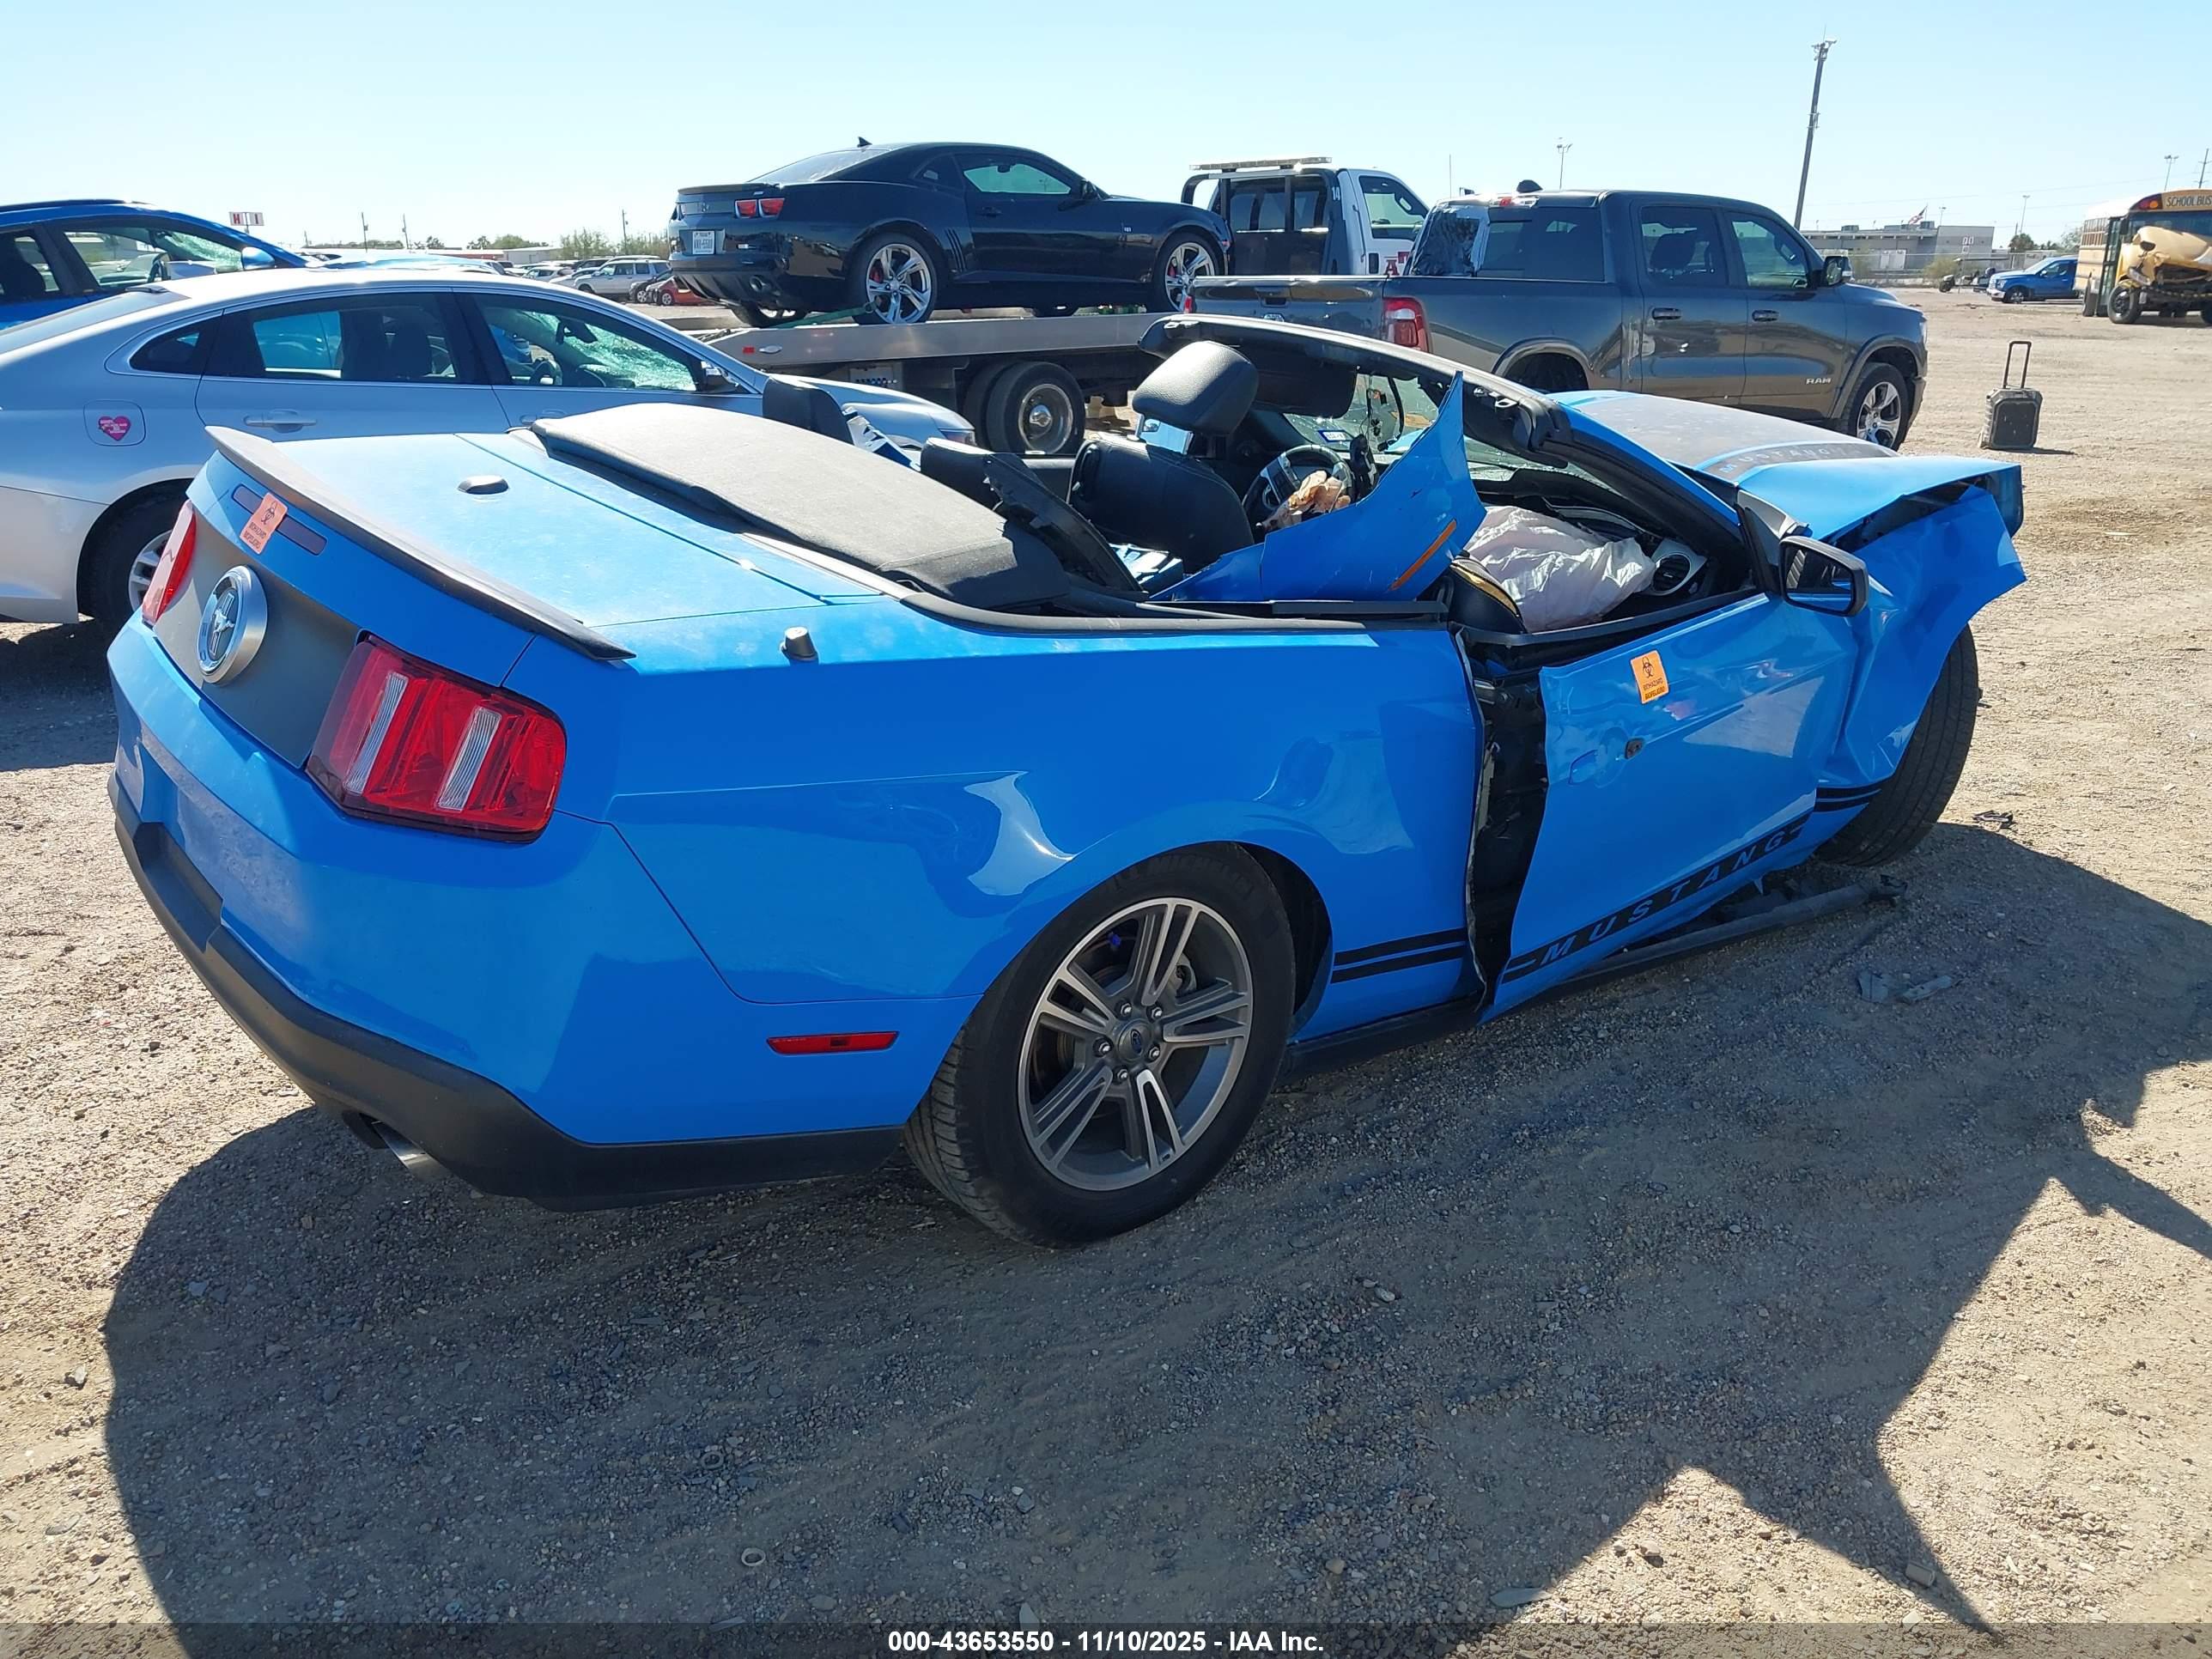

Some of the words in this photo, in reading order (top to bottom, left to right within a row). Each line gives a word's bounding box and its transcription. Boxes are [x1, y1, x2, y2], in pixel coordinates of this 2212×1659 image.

[2166, 195, 2196, 207] SCHOOL
[2197, 195, 2212, 206] BUS
[1718, 447, 1831, 473] MUSTANG
[1542, 830, 1785, 965] MUSTANG
